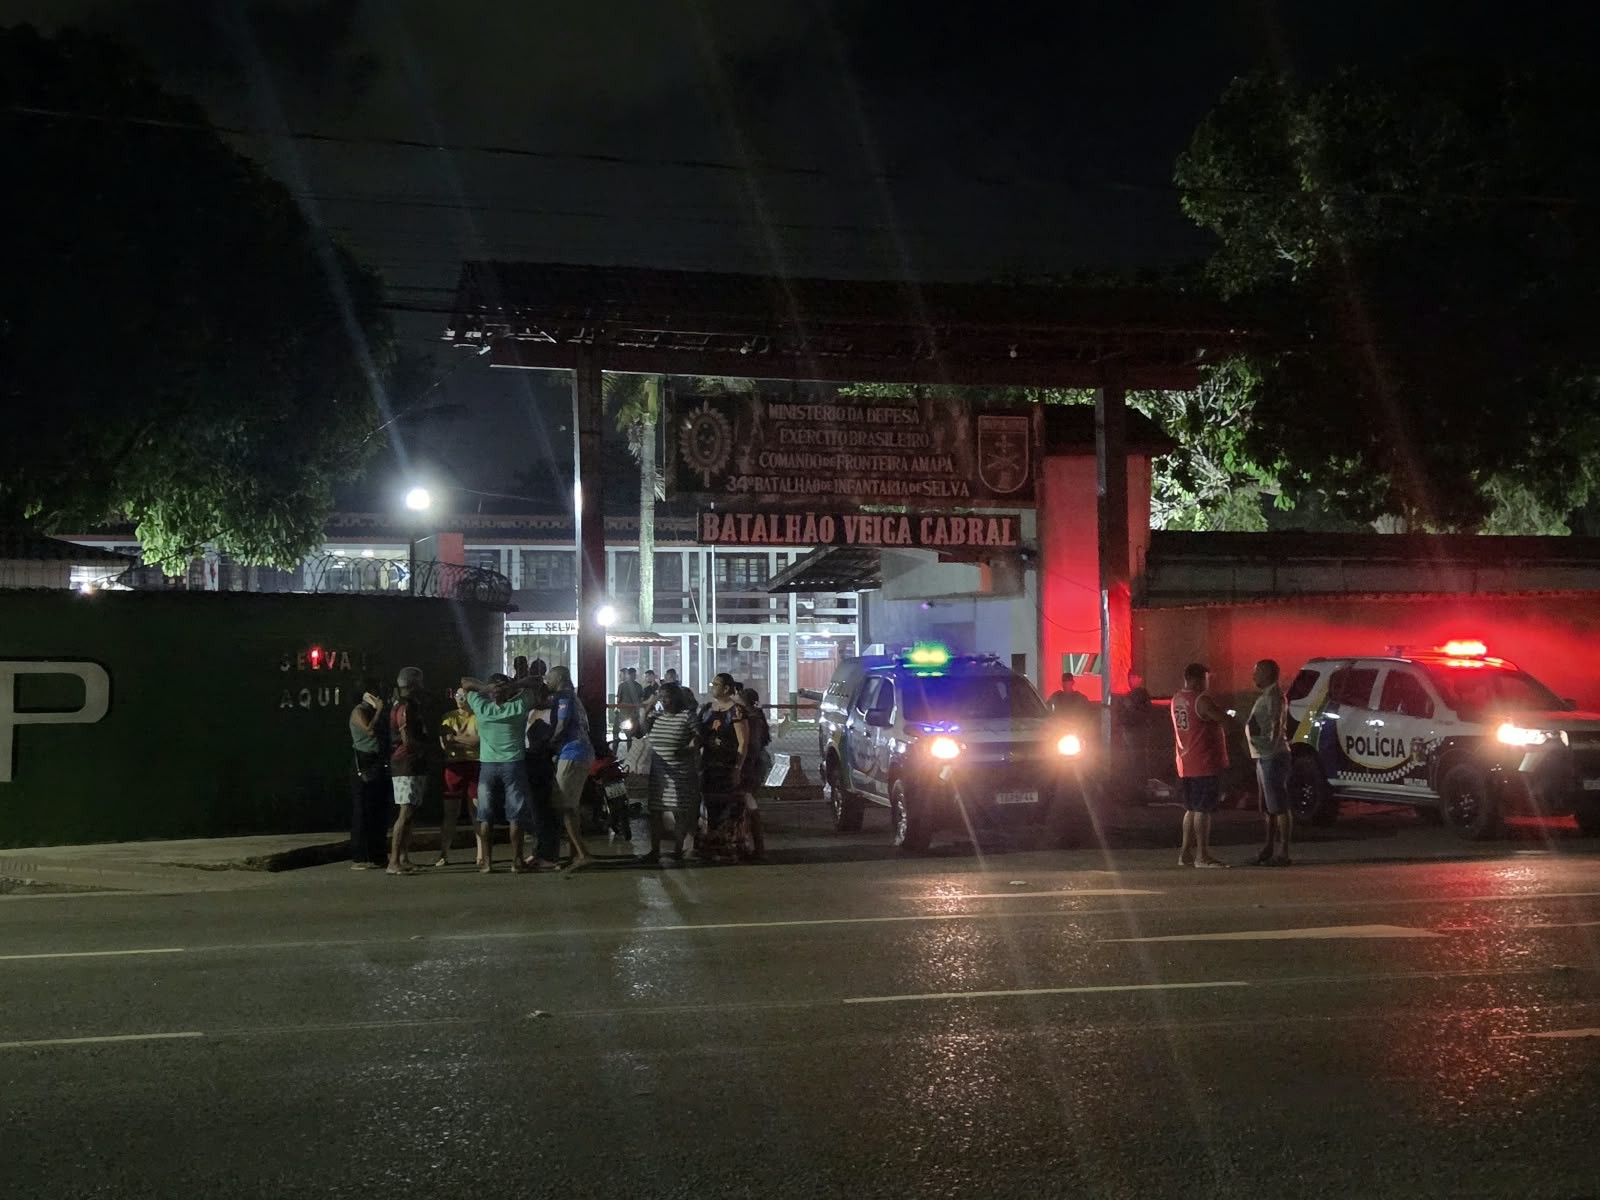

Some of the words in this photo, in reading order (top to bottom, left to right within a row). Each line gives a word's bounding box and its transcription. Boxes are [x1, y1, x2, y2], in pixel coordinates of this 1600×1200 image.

[847, 407, 864, 422] DA
[866, 408, 919, 424] DEFESA
[849, 430, 929, 448] BRASILEIRO
[759, 452, 822, 469] COMANDO
[836, 454, 908, 472] FRONTEIRA
[834, 479, 909, 496] INFANTARIA
[922, 481, 970, 497] SELVA
[702, 512, 835, 543] BATALHÃO
[843, 516, 912, 545] VEIGA
[919, 517, 1017, 546] CABRAL
[521, 622, 535, 632] DE
[545, 622, 576, 632] SELVA
[279, 686, 340, 710] AQUI
[0, 661, 110, 782] P
[1346, 732, 1406, 758] POLÍCIA
